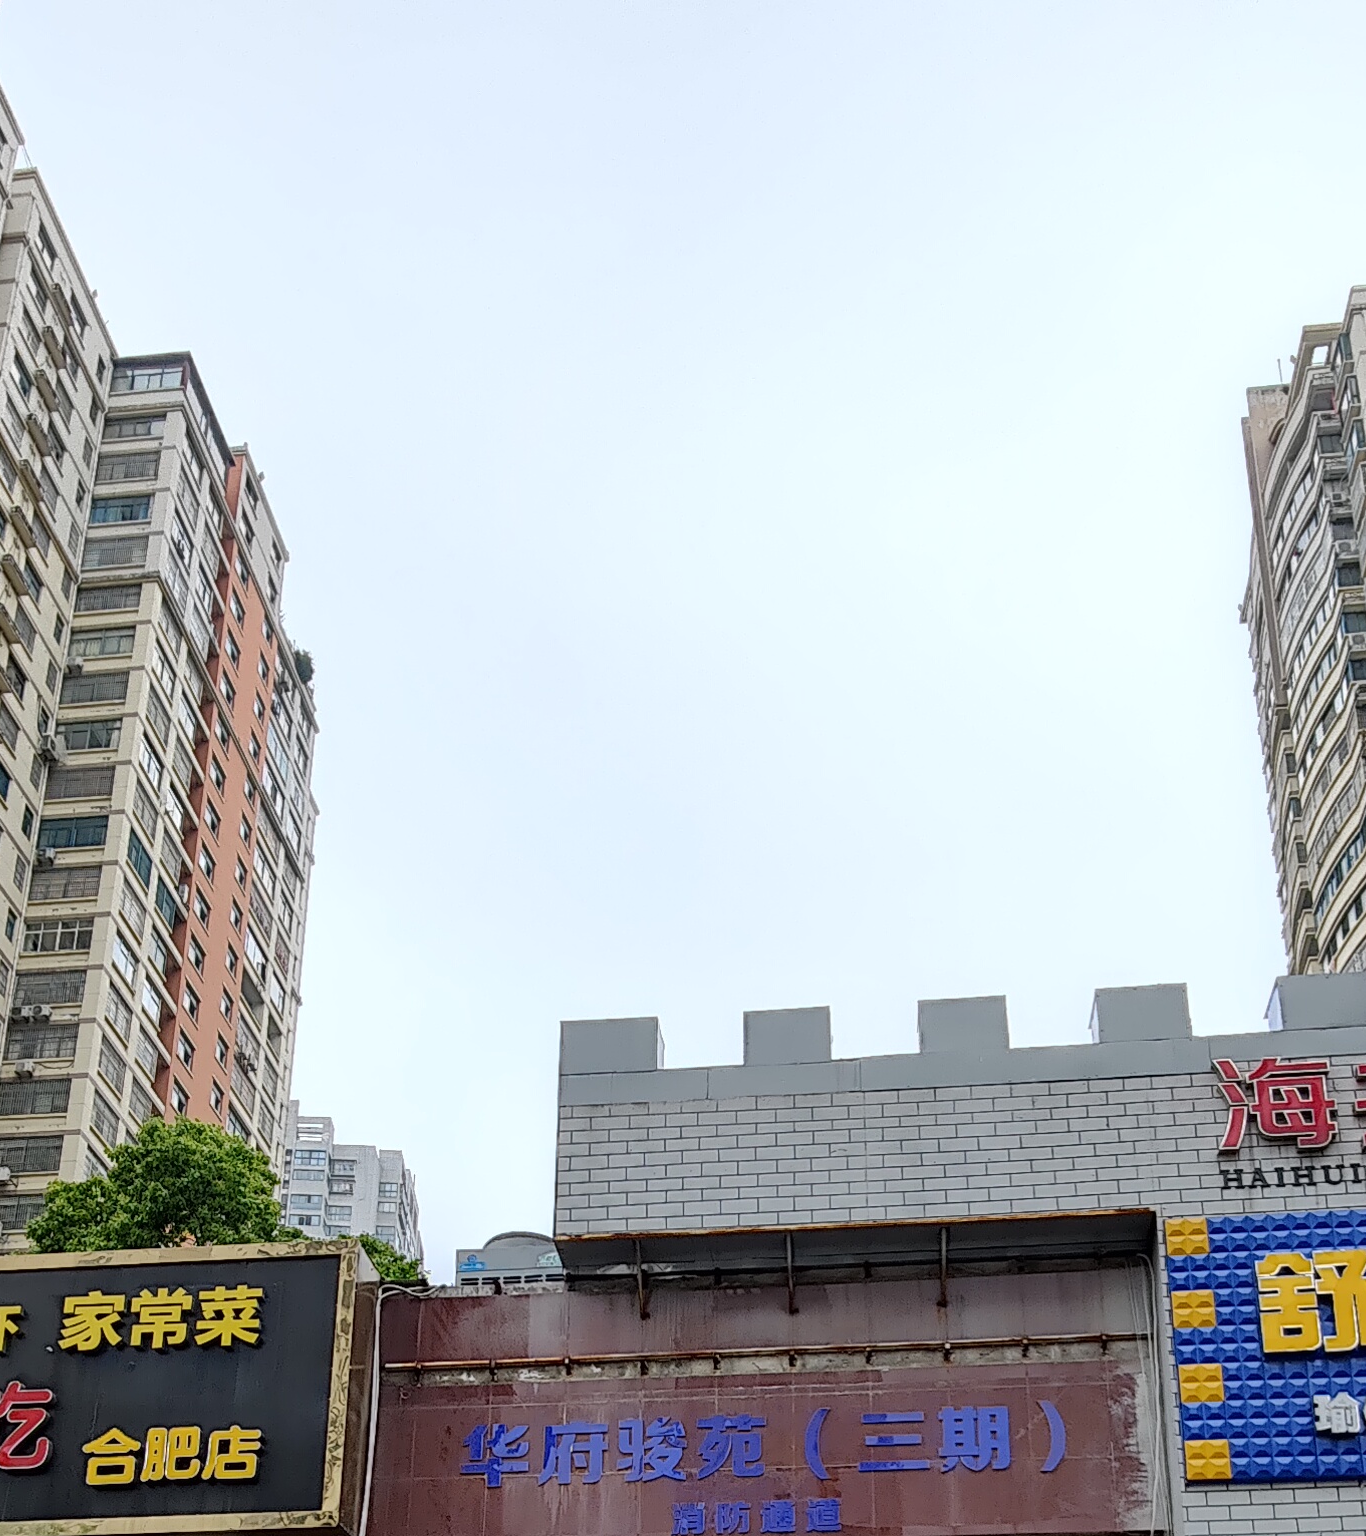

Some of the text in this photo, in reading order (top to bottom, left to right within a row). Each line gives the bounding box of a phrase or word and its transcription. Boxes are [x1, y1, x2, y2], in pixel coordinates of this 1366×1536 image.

[1219, 1162, 1363, 1192] HAIHUI
[57, 1282, 263, 1354] 家常菜
[81, 1424, 263, 1488] 合肥店
